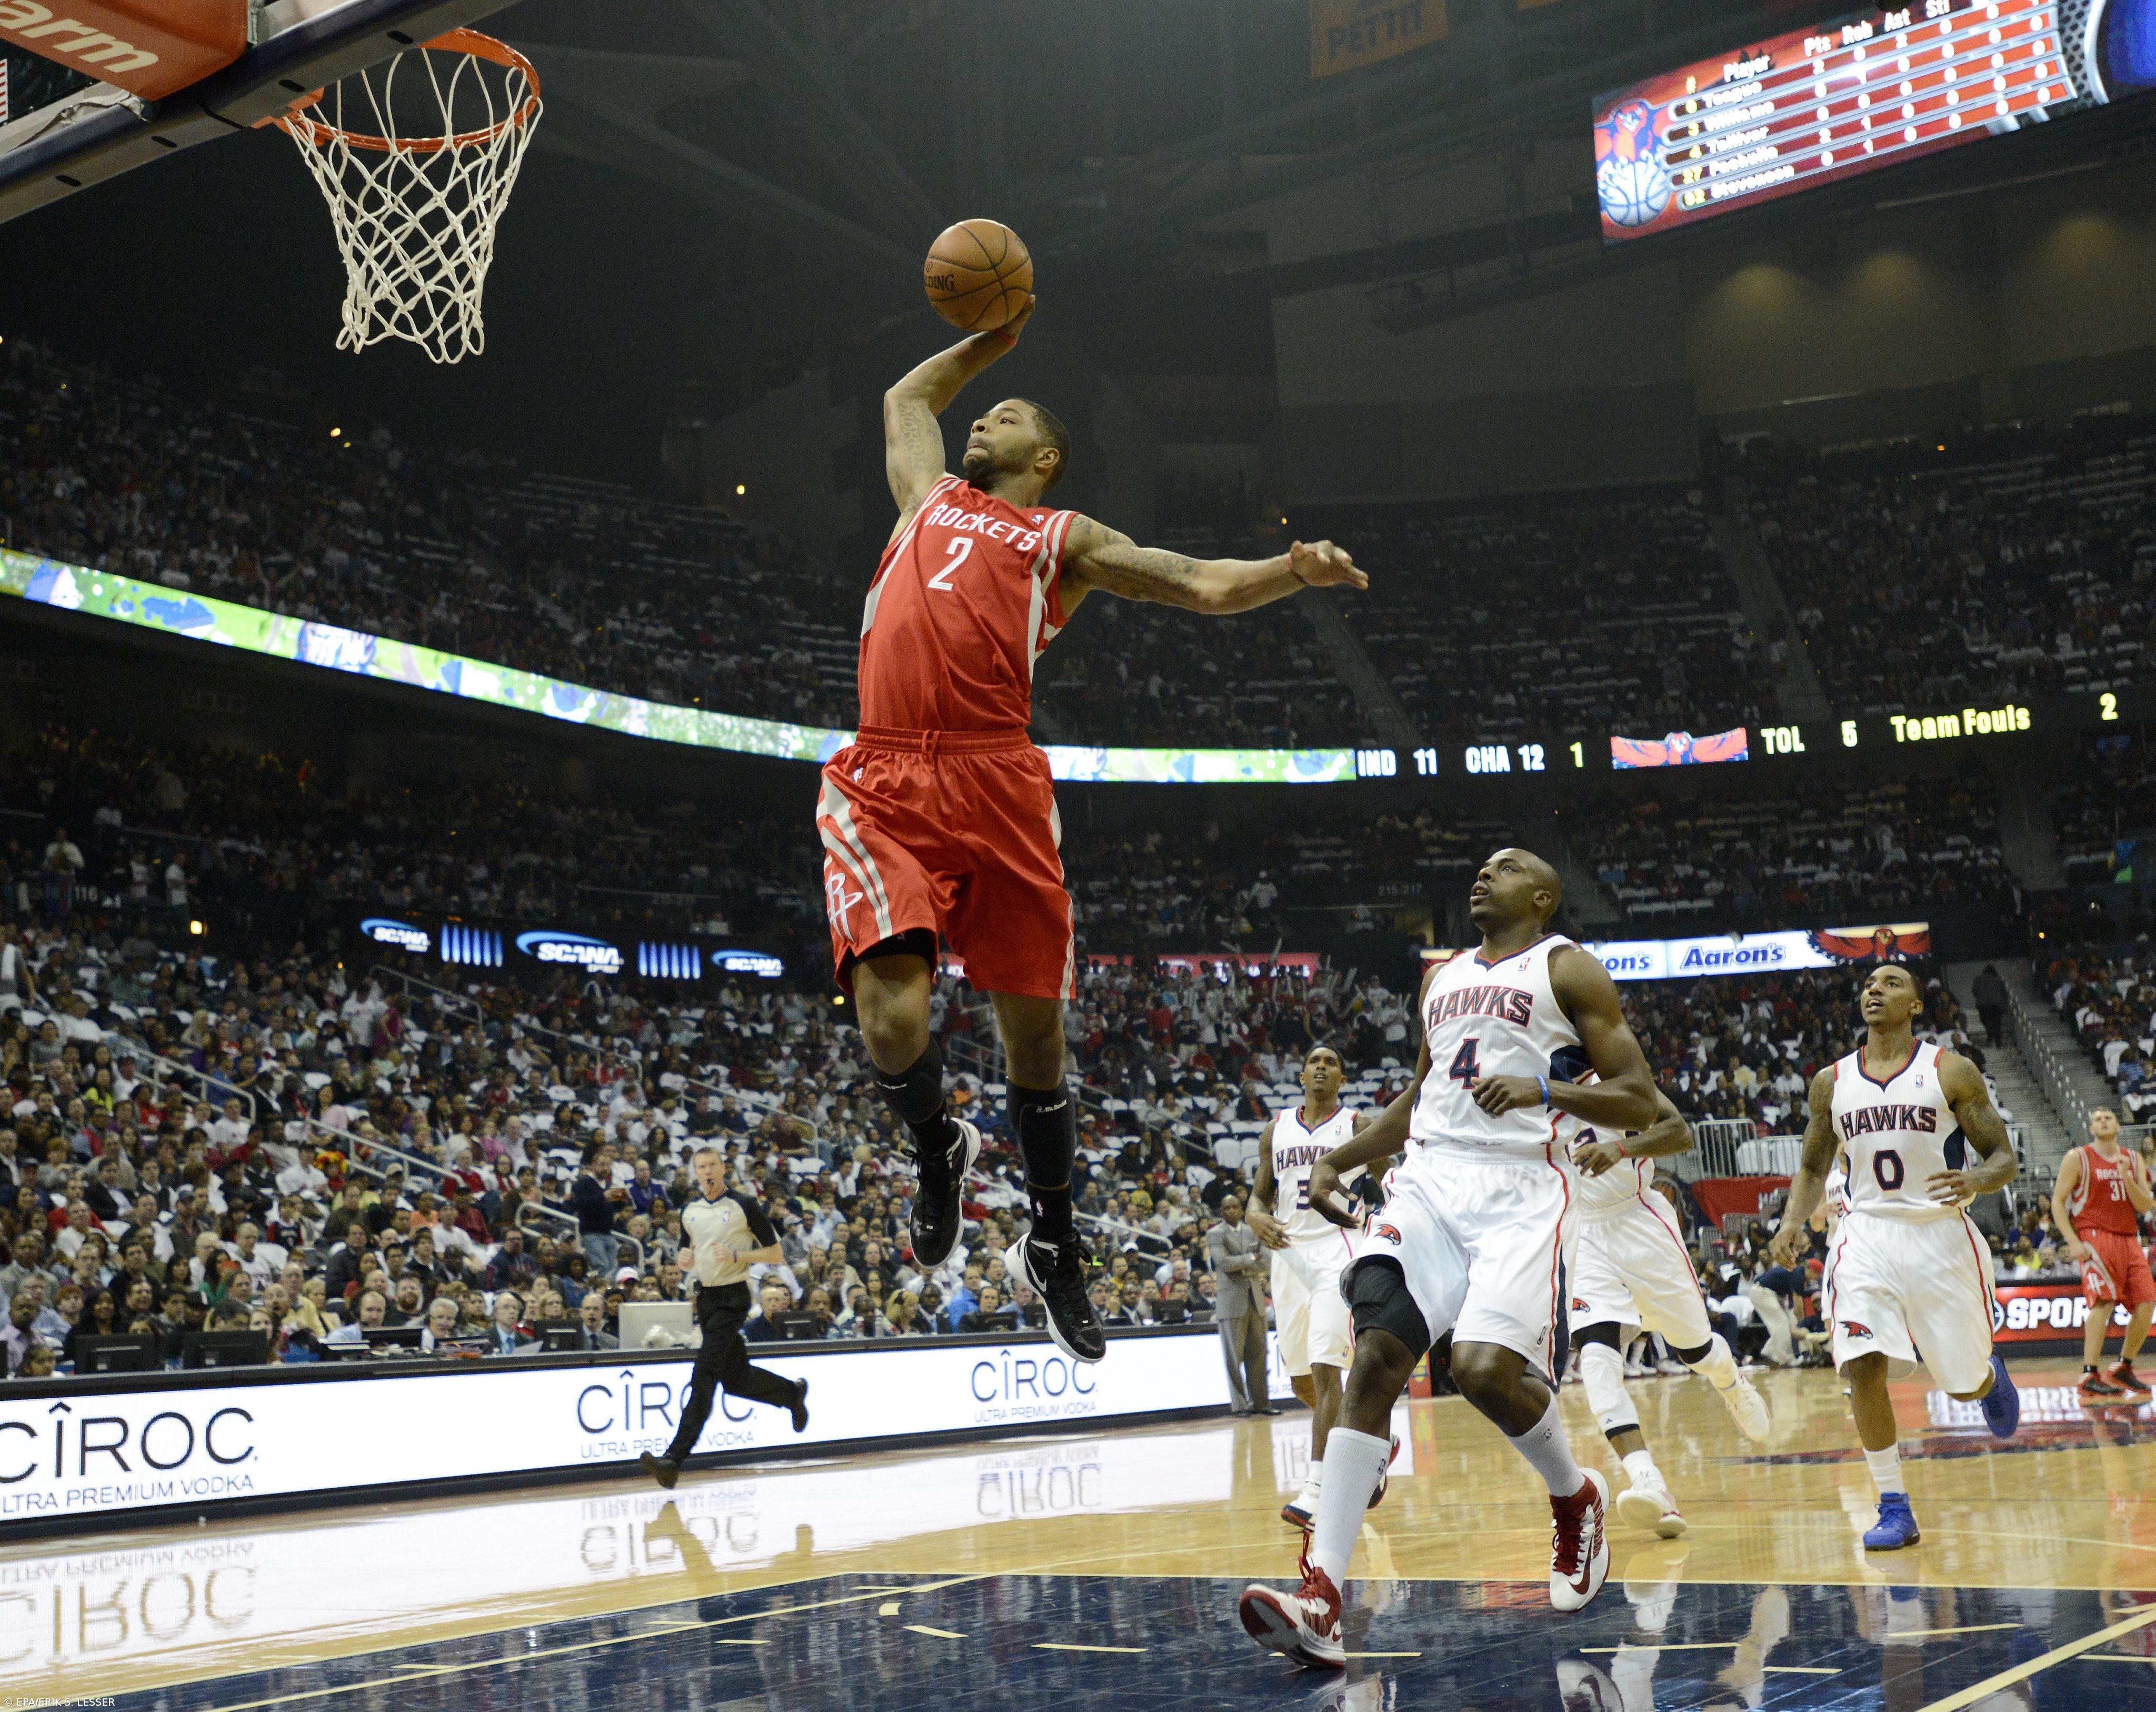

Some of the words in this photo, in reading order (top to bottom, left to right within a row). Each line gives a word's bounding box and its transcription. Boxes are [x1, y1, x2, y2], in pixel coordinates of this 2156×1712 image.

[1804, 35, 1831, 57] Pts
[1884, 8, 1911, 33] Ast
[1854, 46, 1866, 62] 0
[1940, 18, 1952, 34] 0
[1987, 4, 1999, 19] 0
[1814, 81, 1827, 98] 0
[1898, 56, 1910, 72] 0
[1942, 43, 1954, 59] 0
[1989, 28, 2002, 44] 0
[2030, 15, 2043, 31] 0
[1816, 106, 1829, 122] 0
[1858, 93, 1870, 109] 0
[1900, 81, 1913, 97] 0
[1944, 67, 1957, 83] 0
[1991, 53, 2004, 68] 0
[2032, 39, 2045, 56] 0
[1902, 103, 1915, 119] 0
[1947, 89, 1959, 106] 0
[1993, 75, 2006, 92] 0
[2035, 63, 2048, 79] 0
[1821, 151, 1834, 166] 0
[1904, 126, 1917, 142] 0
[1949, 113, 1962, 129] 0
[1995, 99, 2009, 115] 0
[2037, 87, 2050, 103] 0
[925, 502, 1042, 551] ROCKETS
[927, 537, 973, 591] 2
[1761, 725, 1805, 755] TOL
[1841, 720, 1858, 748] 5
[1890, 713, 1961, 742] Team
[1963, 704, 2031, 735] Fouls
[2100, 692, 2119, 721] 2
[1356, 749, 1396, 777] IND
[1413, 748, 1438, 775] 11
[1465, 745, 1511, 774] CHA
[1518, 743, 1545, 771] 12
[1570, 741, 1583, 768] 1
[374, 927, 428, 946] SCANA
[537, 942, 620, 965] SCANA
[1682, 943, 1785, 969] Aaron's
[725, 957, 782, 971] SCANA
[1600, 952, 1652, 971] on's
[1429, 985, 1533, 1031] HAWKS
[1449, 1038, 1480, 1090] 4
[1839, 1104, 1937, 1141] HAWKS
[1276, 1146, 1334, 1172] HAWK
[1873, 1150, 1904, 1191] 0
[2110, 1180, 2126, 1201] 31
[2007, 1297, 2132, 1330] SPORS
[974, 1408, 1007, 1423] ULTRA
[1011, 1405, 1060, 1419] PREMIUM
[1063, 1401, 1096, 1415] VODKA
[580, 1441, 628, 1459] ULTRA
[708, 1430, 754, 1447] VODKA
[2, 1491, 58, 1514] LTRA
[66, 1479, 174, 1508] PREMIUM
[180, 1474, 254, 1496] VODKA
